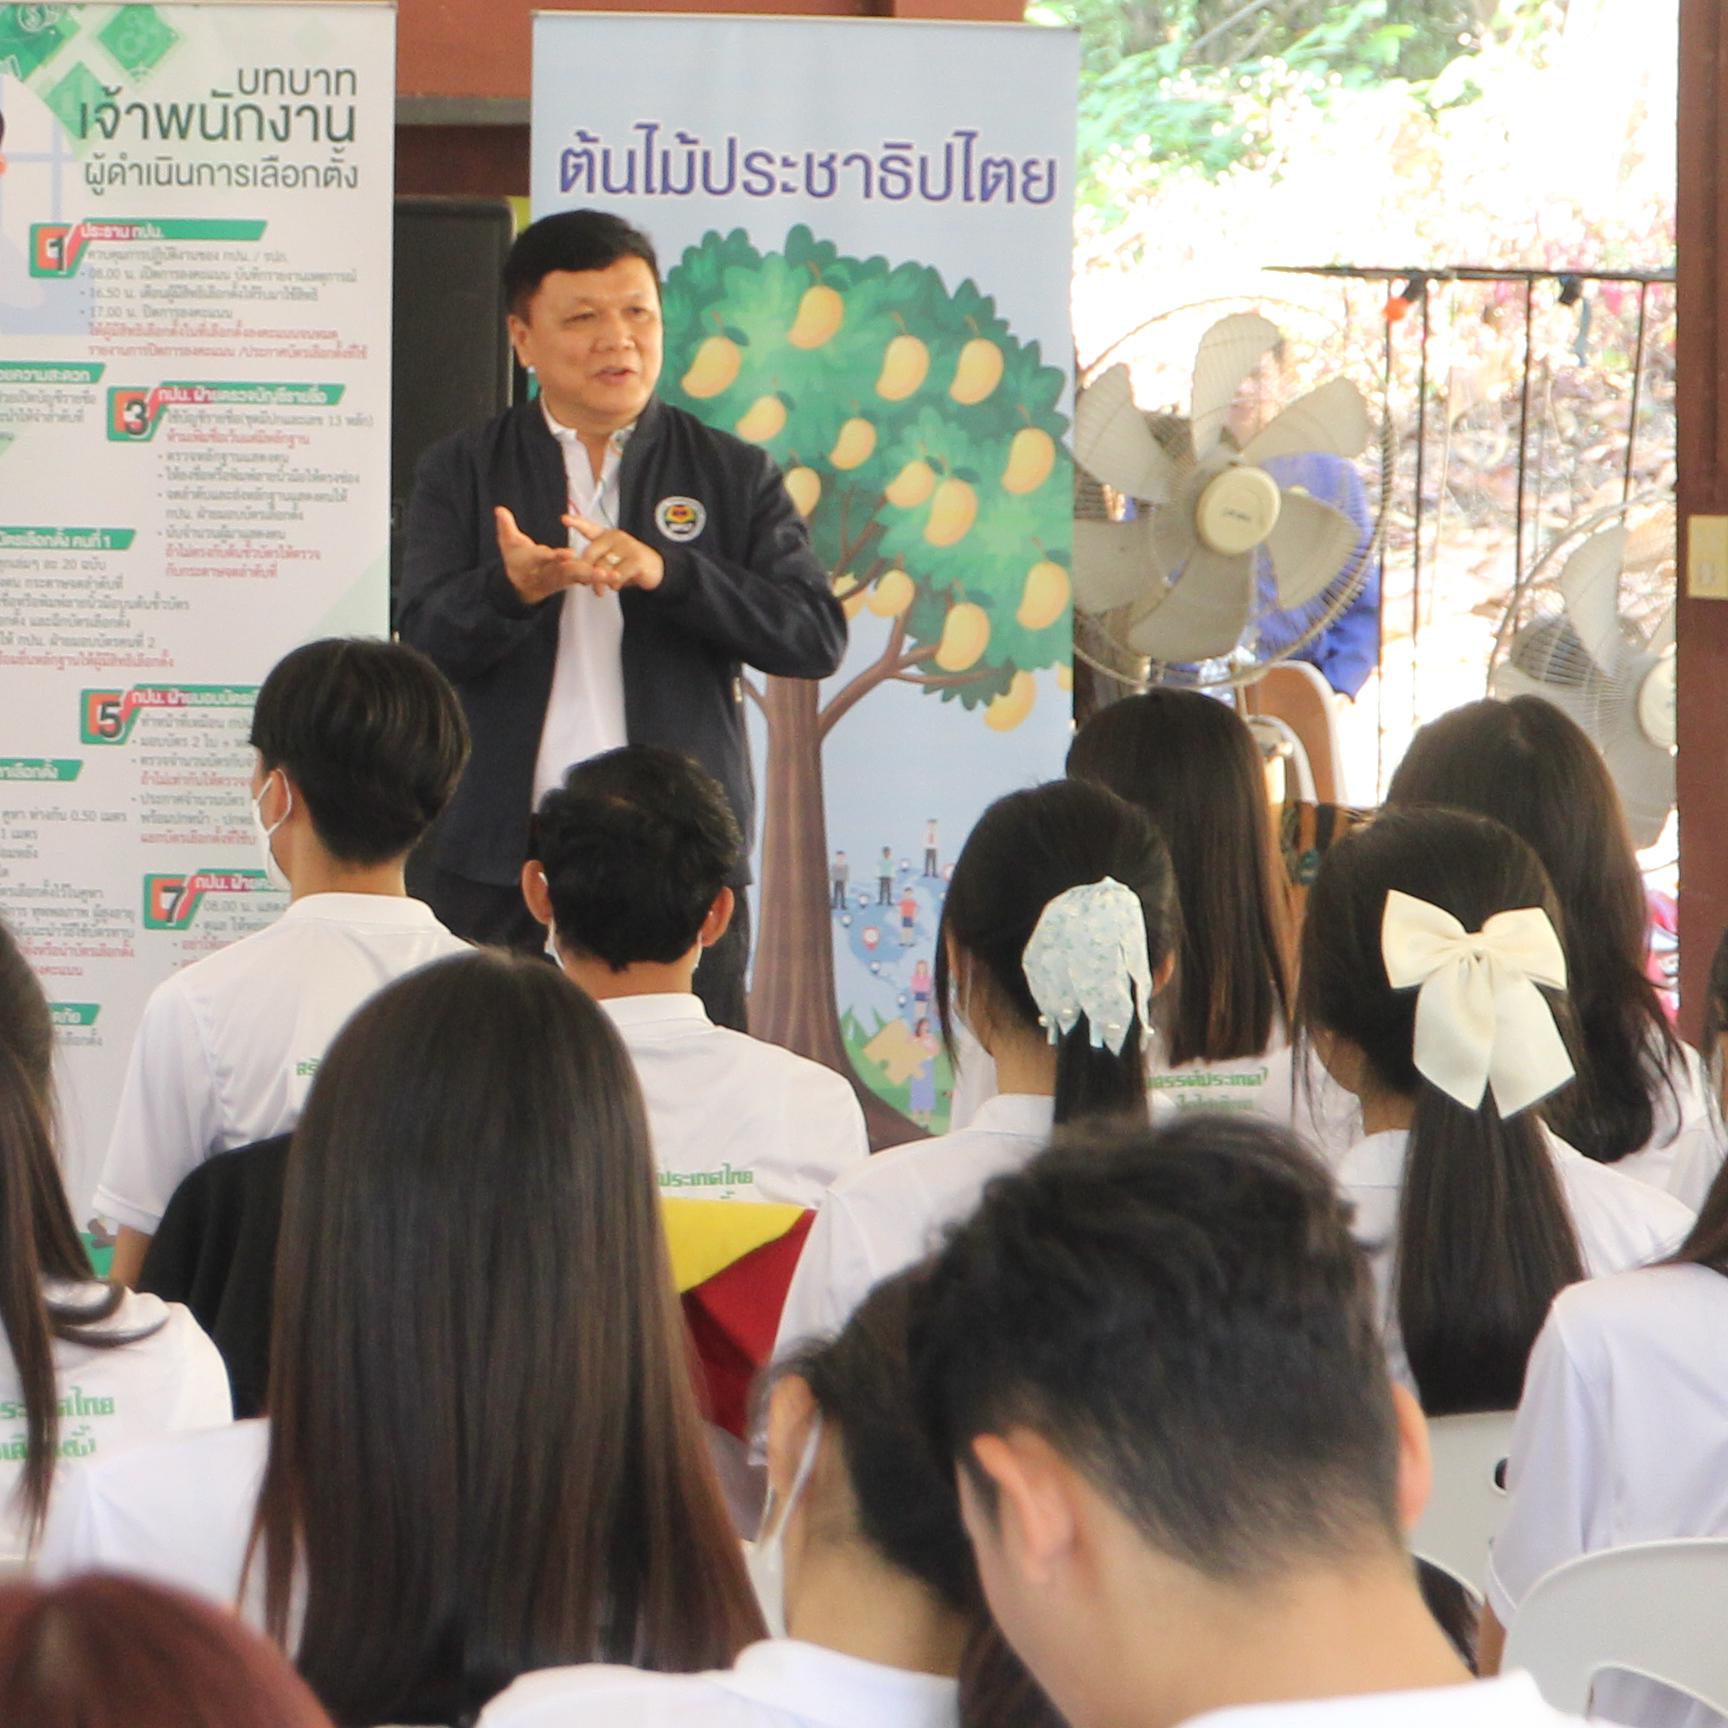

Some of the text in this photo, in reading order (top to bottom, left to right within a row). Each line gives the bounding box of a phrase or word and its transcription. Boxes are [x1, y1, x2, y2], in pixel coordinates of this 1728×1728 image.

[238, 67, 358, 97] บทบาท
[79, 85, 356, 143] เจ้าพนักงาน
[84, 148, 359, 195] ผู้ดำเนินการเลือกตั้ง
[558, 123, 1057, 206] ต้นไม้ประชาธิปไตย
[81, 223, 130, 241] ประธาน
[123, 399, 150, 436] 3
[98, 701, 124, 739] 5
[162, 885, 187, 926] 7
